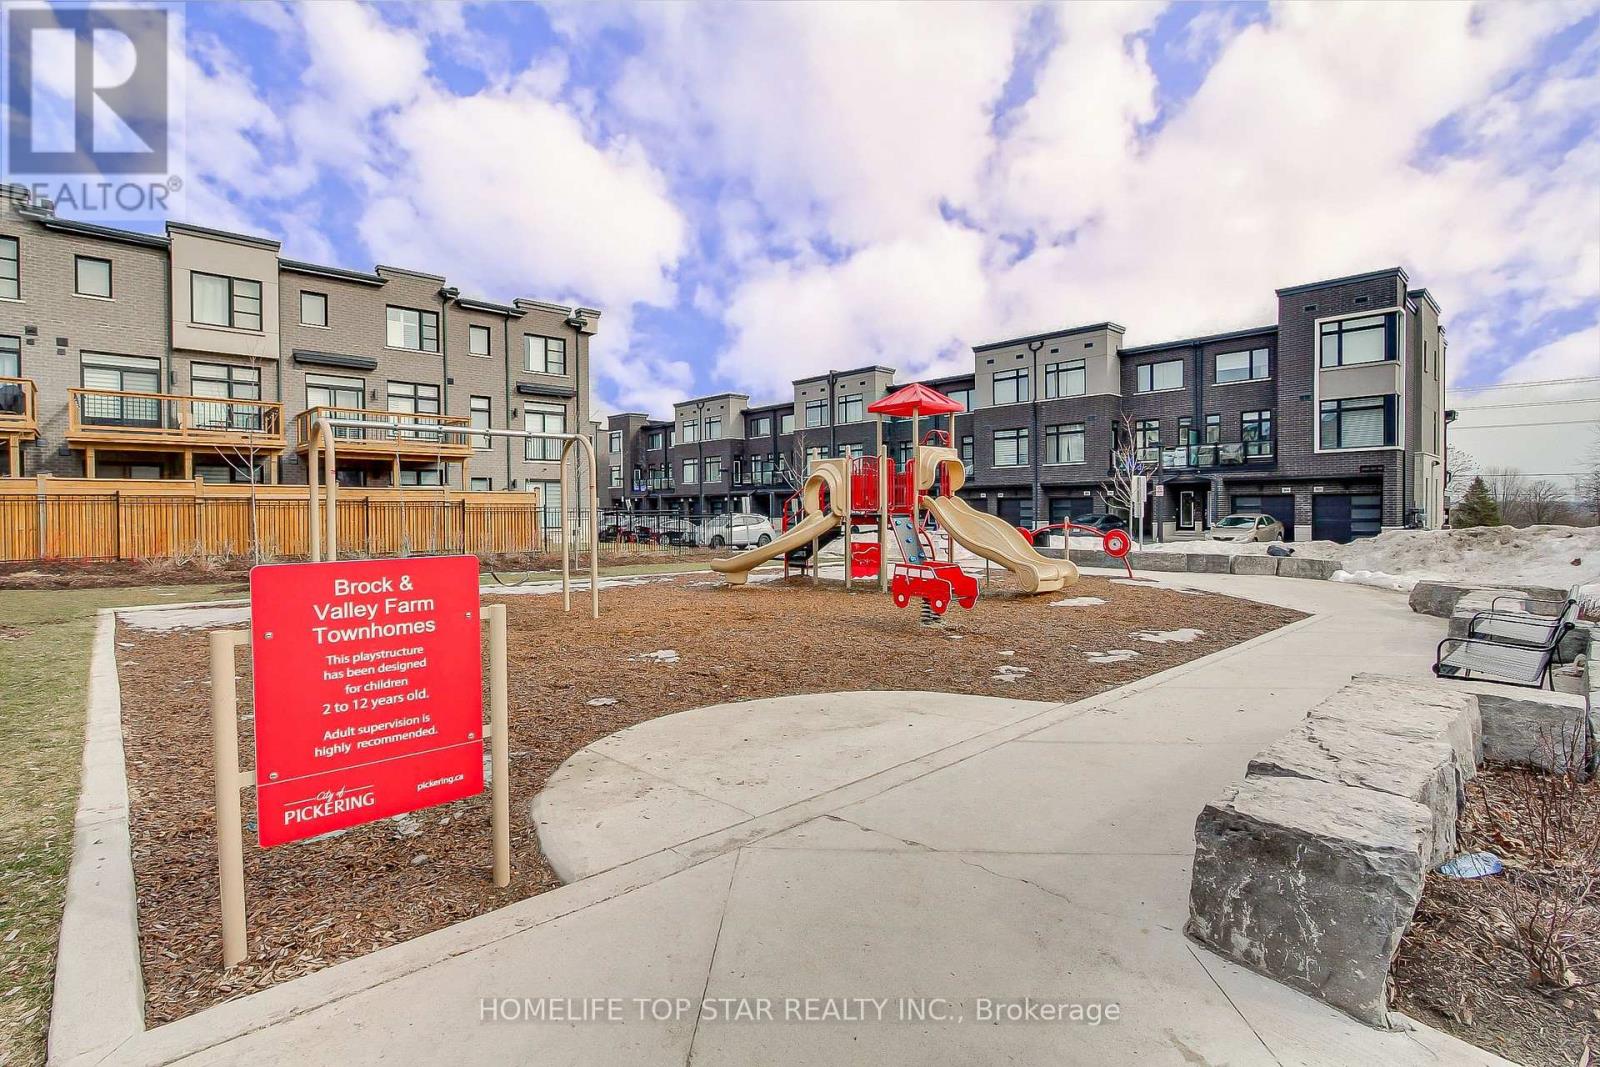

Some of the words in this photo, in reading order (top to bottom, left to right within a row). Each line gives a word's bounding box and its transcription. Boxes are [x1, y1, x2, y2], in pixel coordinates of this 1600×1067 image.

[334, 576, 393, 596] Brock
[399, 575, 414, 591] &
[313, 602, 378, 621] Valley
[385, 597, 435, 615] Farm
[312, 619, 436, 644] Townhomes
[326, 653, 351, 666] This
[352, 645, 424, 664] playstructure
[323, 669, 345, 681] has
[346, 664, 375, 678] been
[377, 658, 427, 676] designed
[344, 682, 362, 695] for
[364, 676, 408, 692] children
[322, 703, 331, 715] 2
[334, 700, 349, 713] to
[353, 697, 368, 710] 12
[371, 694, 404, 711] years
[407, 688, 430, 701] old.
[323, 726, 355, 741] Adult
[358, 716, 420, 737] supervision
[422, 713, 431, 723] is
[314, 742, 351, 758] highly
[357, 726, 439, 748] recommended.
[316, 789, 335, 803] City
[336, 784, 346, 798] of
[416, 773, 464, 792] pickering.ca
[284, 792, 375, 825] PICKERING
